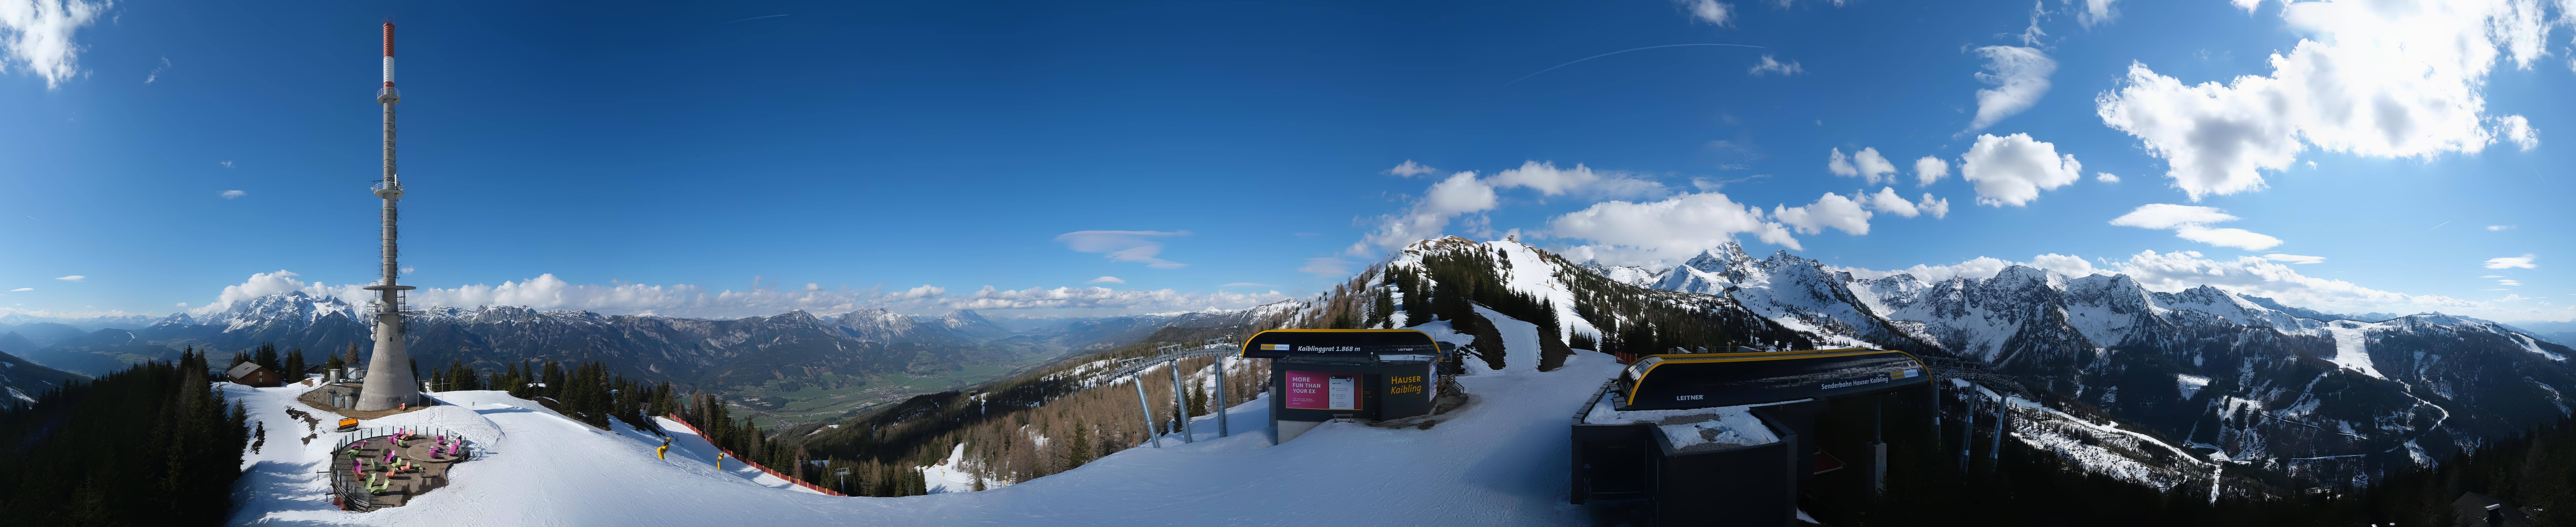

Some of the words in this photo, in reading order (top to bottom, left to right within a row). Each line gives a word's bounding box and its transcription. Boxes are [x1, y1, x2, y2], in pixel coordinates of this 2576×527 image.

[1391, 376, 1421, 384] HAUSER
[1391, 384, 1421, 394] Kaibling
[1821, 381, 1852, 390] Senderbahn
